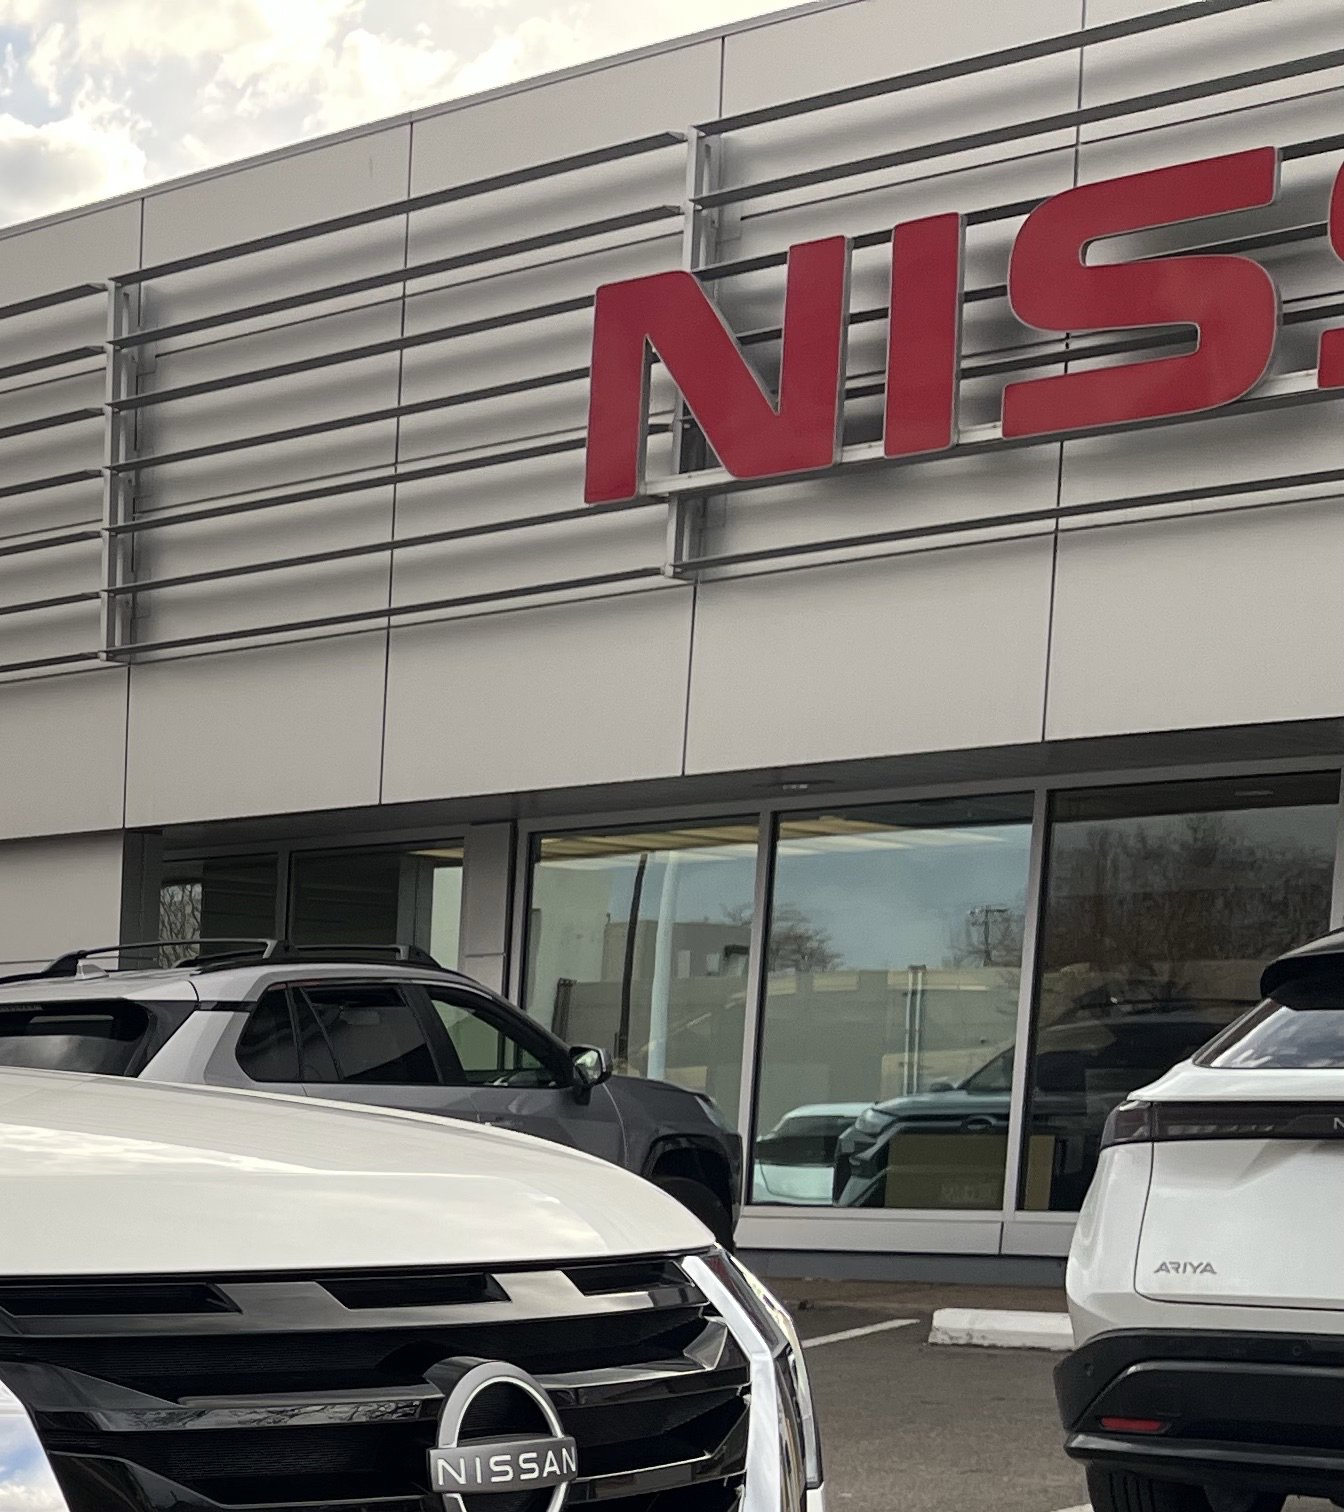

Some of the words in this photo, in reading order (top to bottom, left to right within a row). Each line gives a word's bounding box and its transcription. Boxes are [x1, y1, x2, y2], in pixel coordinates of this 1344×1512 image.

[583, 145, 1344, 505] NIS
[1153, 1261, 1217, 1275] ARIYA
[437, 1446, 577, 1486] NISSAN
